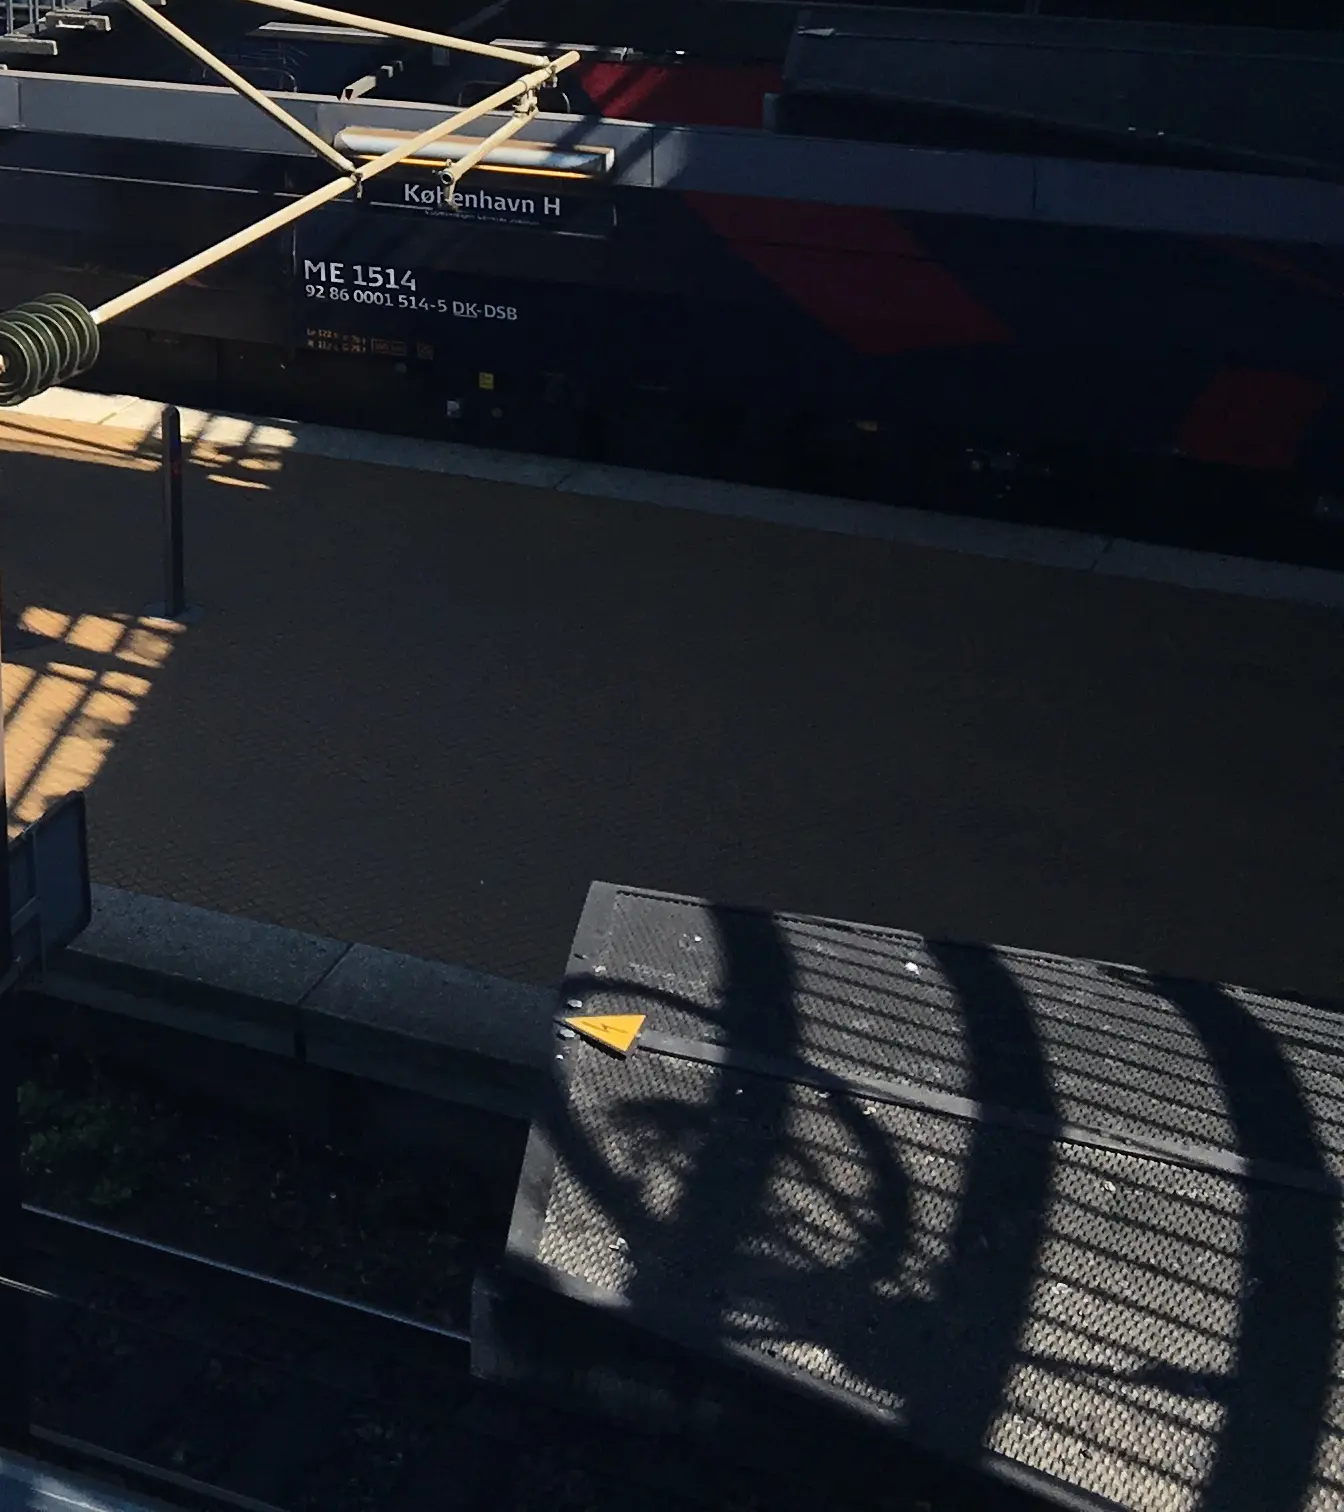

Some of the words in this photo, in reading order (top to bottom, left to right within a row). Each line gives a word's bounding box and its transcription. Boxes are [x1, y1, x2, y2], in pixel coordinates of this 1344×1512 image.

[544, 196, 561, 216] H
[304, 259, 345, 284] ME
[353, 264, 417, 291] 1514
[305, 284, 326, 299] 92
[329, 286, 350, 301] 86
[353, 289, 394, 307] 0001
[398, 295, 448, 313] 514-5
[452, 301, 518, 321] DK-DSB
